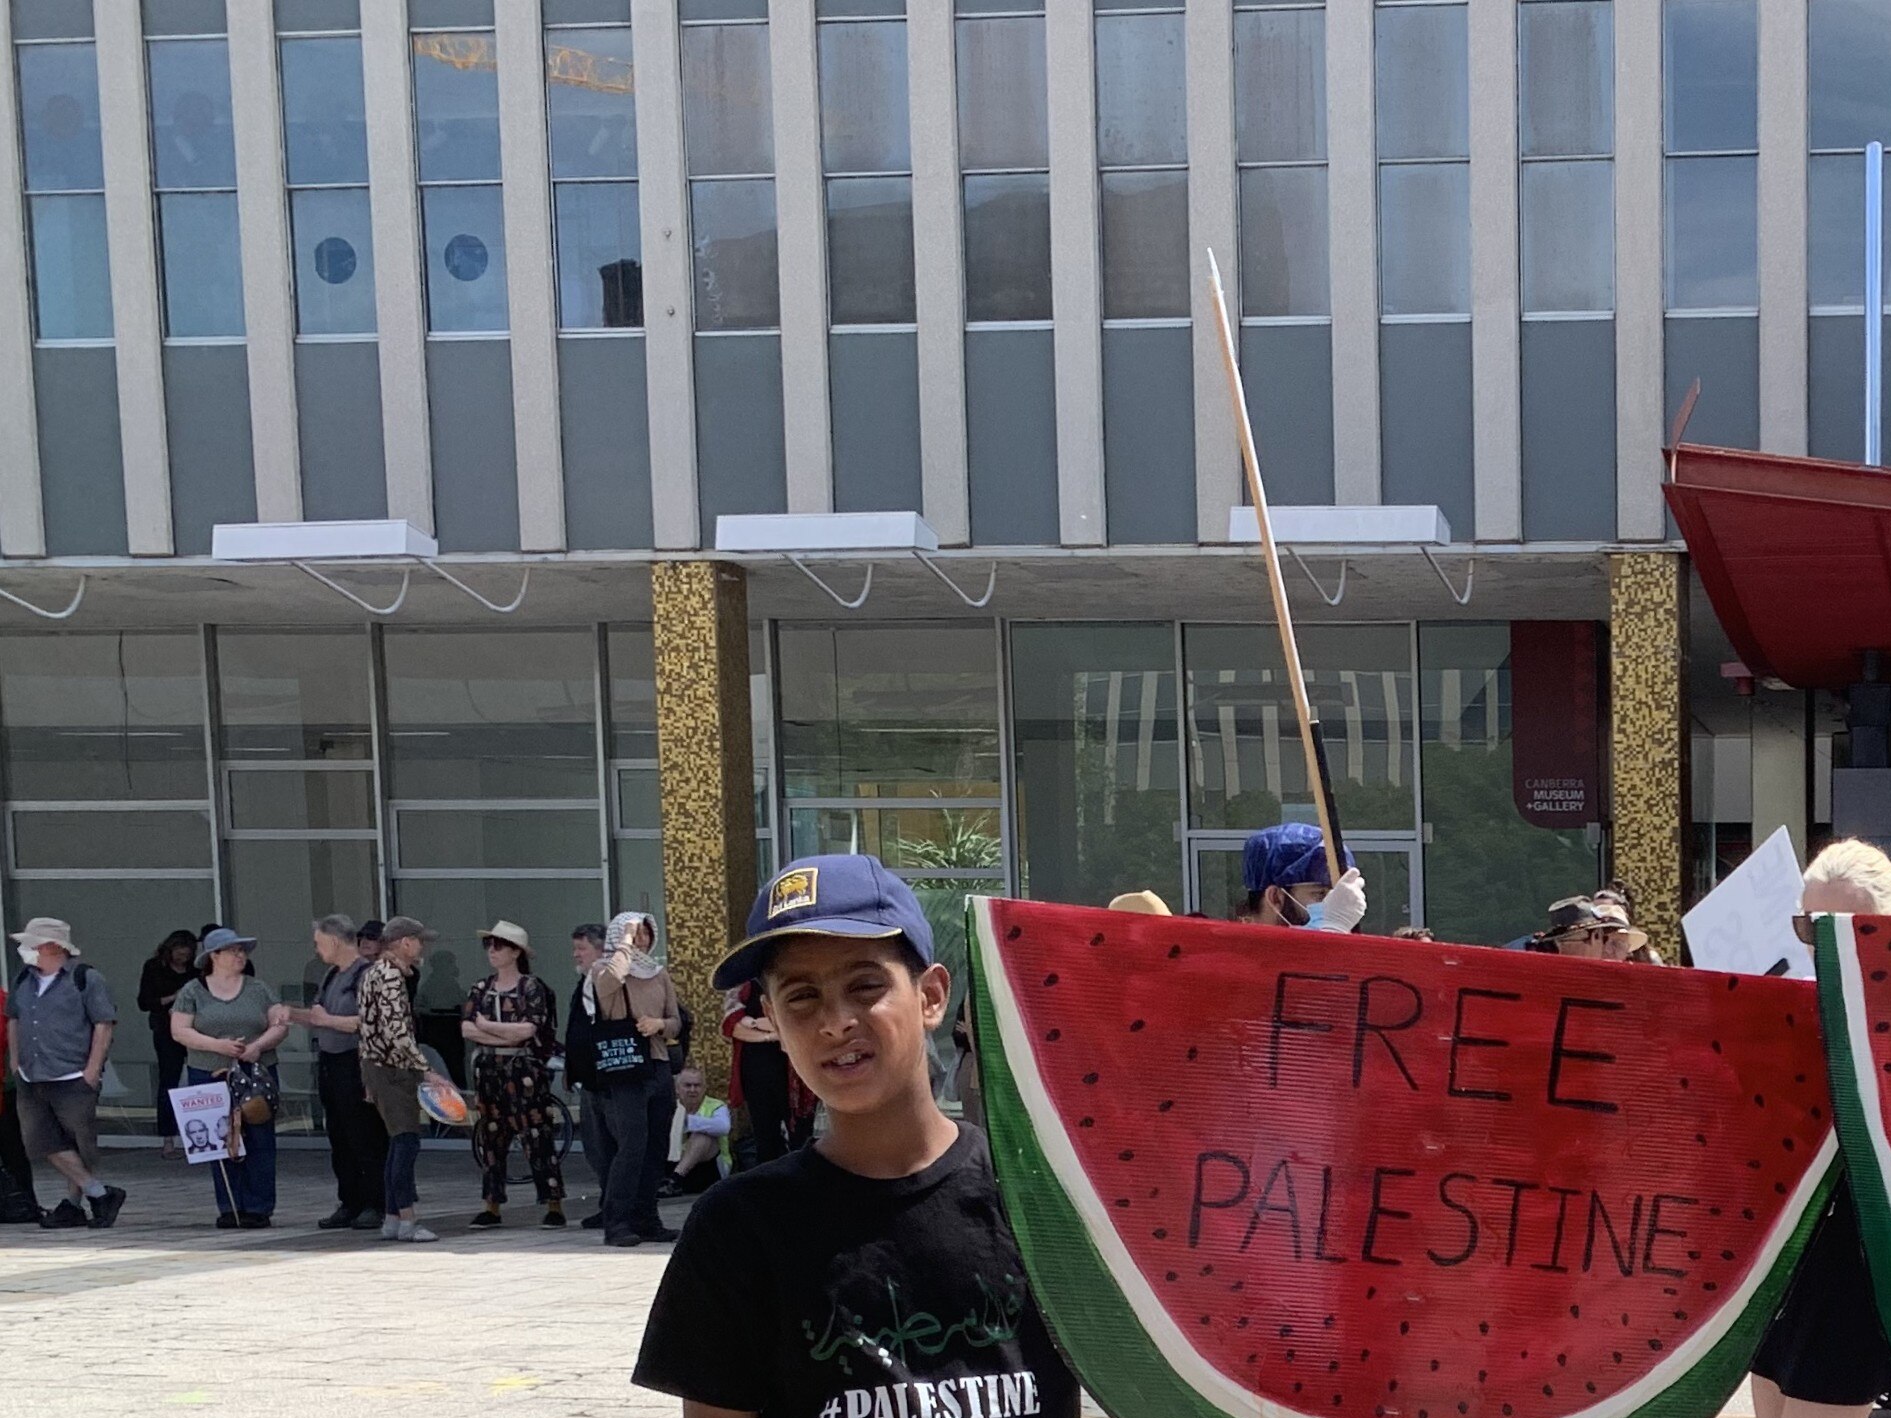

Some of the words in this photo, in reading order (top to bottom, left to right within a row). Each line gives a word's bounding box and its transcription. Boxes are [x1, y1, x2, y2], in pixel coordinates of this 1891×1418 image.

[1524, 779, 1586, 789] CANBERRA
[1533, 790, 1585, 800] MUSEUM
[1269, 971, 1626, 1112] FREE
[181, 1095, 223, 1109] WANTED
[1188, 1150, 1701, 1279] PALESTINE
